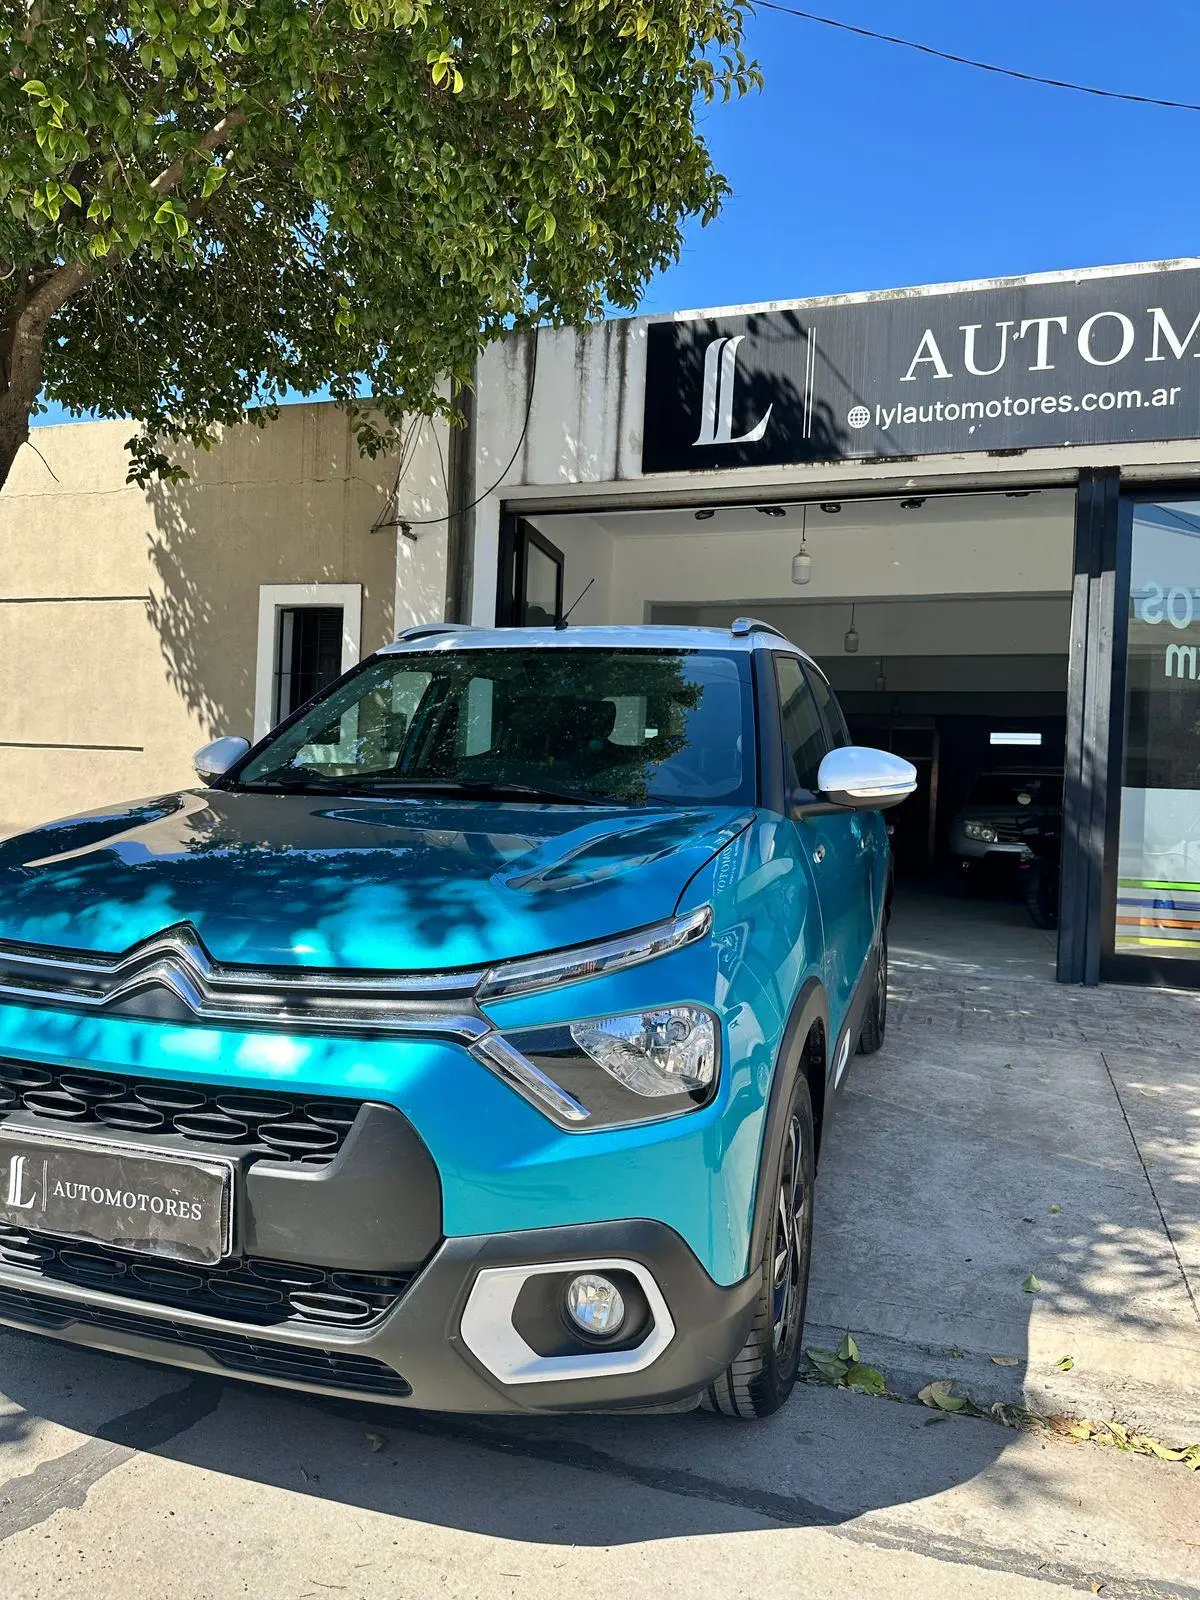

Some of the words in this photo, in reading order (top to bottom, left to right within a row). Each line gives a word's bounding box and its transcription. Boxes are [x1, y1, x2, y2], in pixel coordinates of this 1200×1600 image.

[899, 307, 1200, 382] AUTOM
[875, 386, 1181, 431] lylautomotores.com.ar
[53, 1180, 202, 1221] AUTOMOTORES
